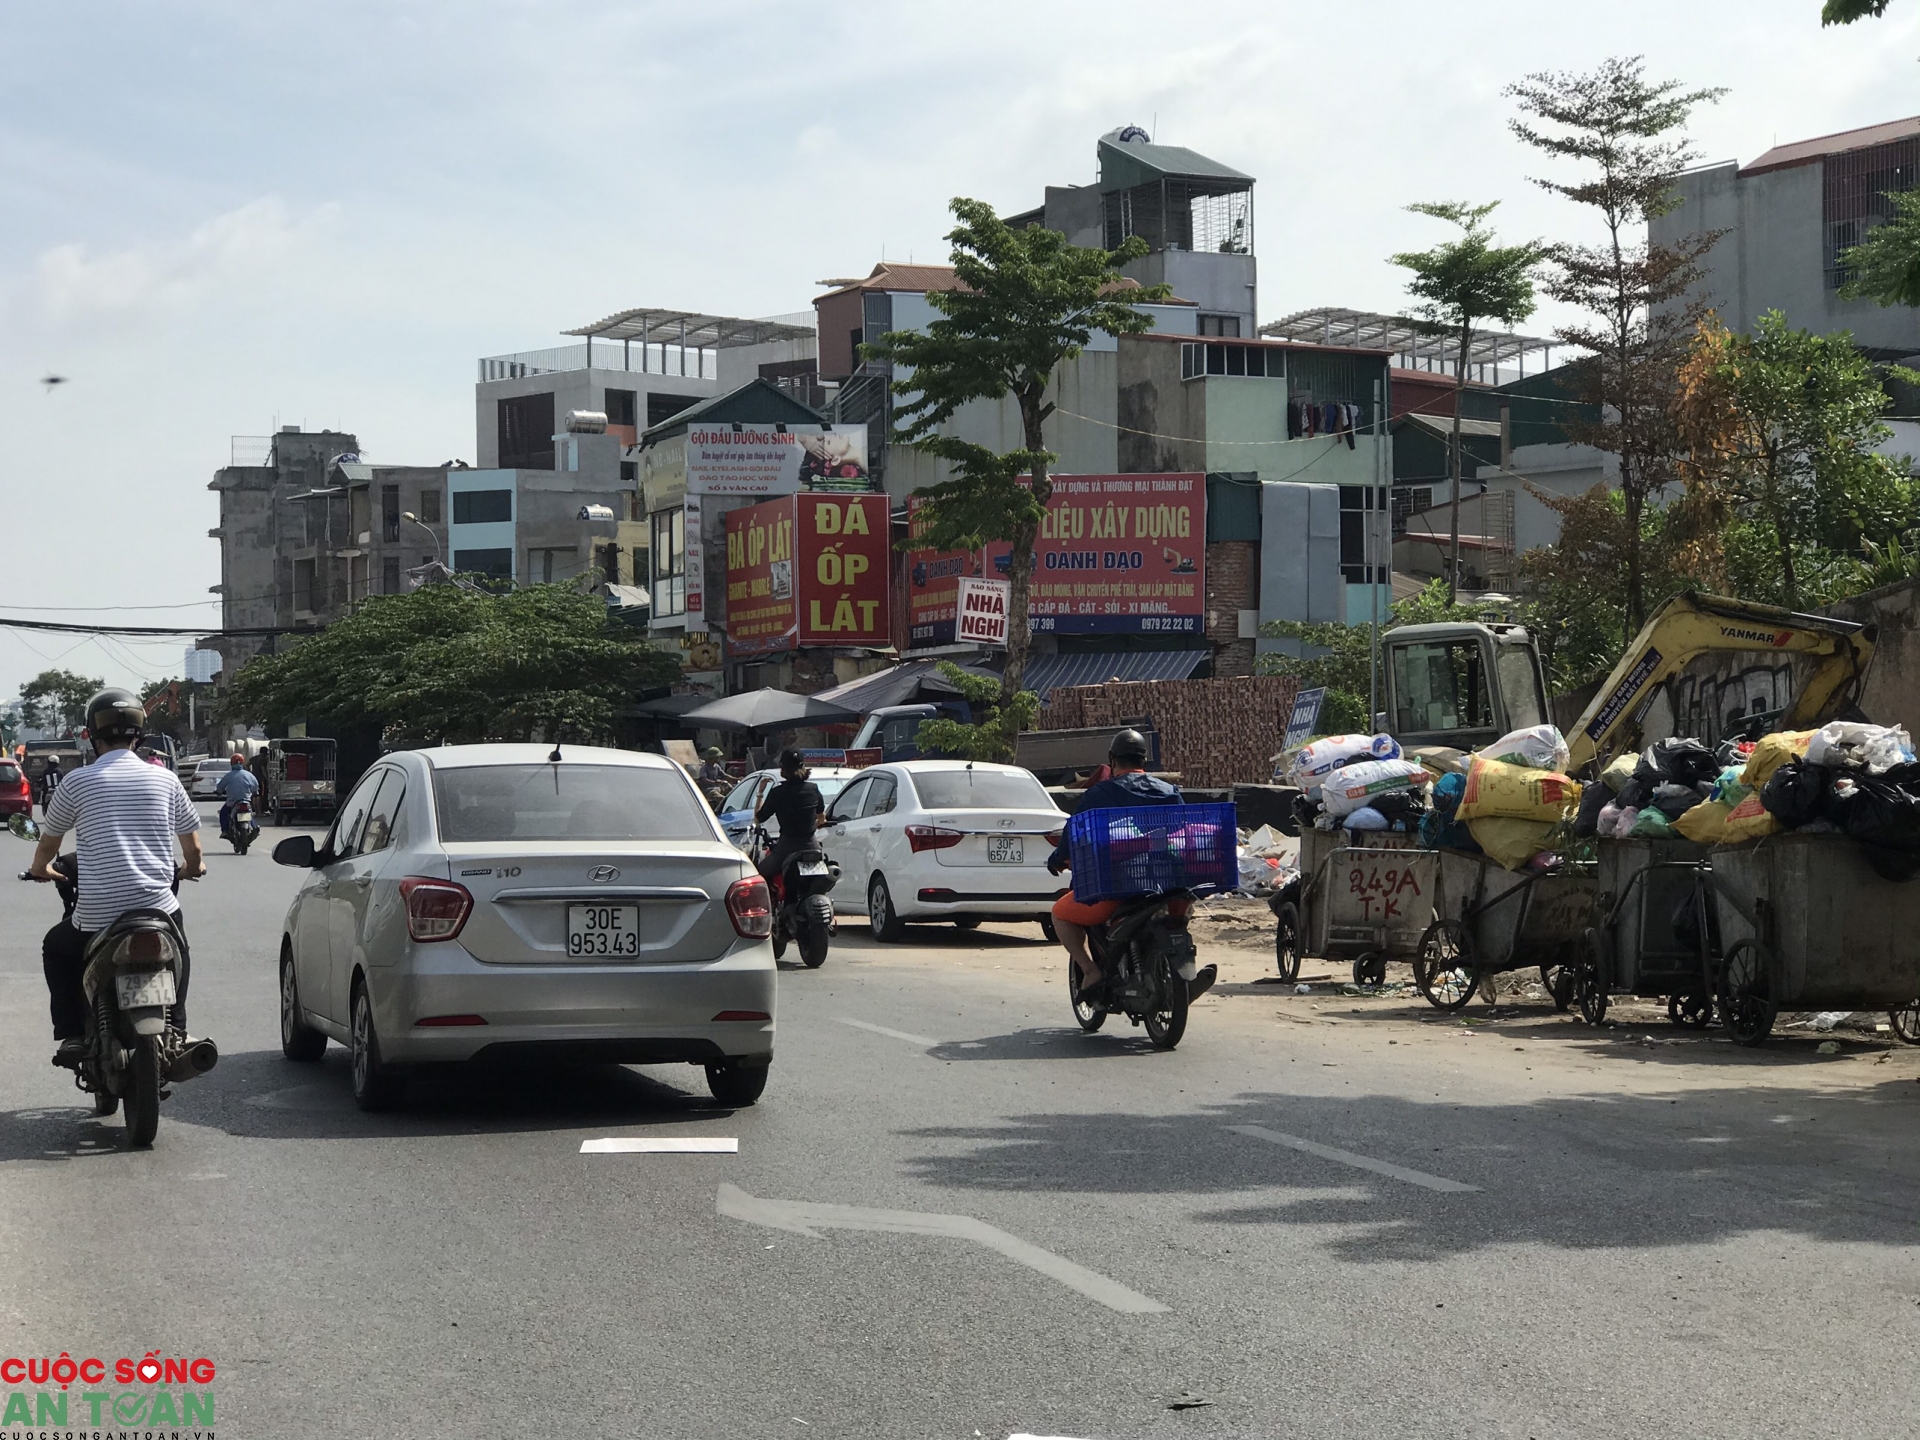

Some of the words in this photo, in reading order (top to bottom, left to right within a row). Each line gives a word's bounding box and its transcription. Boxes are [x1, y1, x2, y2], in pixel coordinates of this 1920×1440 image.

[691, 429, 709, 447] GỘI
[771, 432, 795, 445] SINH
[1069, 481, 1090, 495] DỰNG
[1091, 479, 1101, 493] VÀ
[1103, 481, 1133, 492] THƯƠNG
[1135, 480, 1150, 494] MẠI
[1151, 478, 1177, 492] THÀNH
[814, 496, 870, 535] ĐÁ
[1041, 501, 1084, 546] LIỆU
[1090, 500, 1130, 539] XÂY
[1135, 503, 1190, 546] DỰNG
[748, 512, 765, 567] ỐP
[768, 512, 792, 563] LÁT
[816, 541, 869, 586] ỐP
[930, 559, 948, 579] OANH
[1045, 551, 1098, 570] OANH
[1103, 551, 1143, 574] ĐẠO
[970, 583, 985, 591] SAO
[986, 584, 1004, 593] SÁNG
[1139, 583, 1151, 597] SAN
[810, 593, 879, 632] LÁT
[966, 592, 1005, 615] NHÀ
[1038, 598, 1056, 614] CẤP
[1058, 600, 1071, 614] ĐÁ
[1079, 600, 1097, 614] CÁT
[1104, 599, 1120, 614] SỎI
[1128, 602, 1138, 614] XI
[1140, 600, 1177, 614] MĂNG...
[961, 615, 1006, 638] NGHỈ
[1040, 617, 1055, 630] 399
[1141, 617, 1160, 630] 0979
[1161, 617, 1172, 630] 22
[1172, 617, 1183, 630] 22
[1184, 617, 1194, 630] 02
[1720, 626, 1775, 643] YANMAR
[996, 838, 1015, 850] 30F
[990, 850, 1022, 861] 657.43
[1349, 866, 1421, 898] 249A
[585, 908, 622, 931] 30E
[570, 932, 637, 955] 953.43
[121, 989, 171, 1007] 545.14
